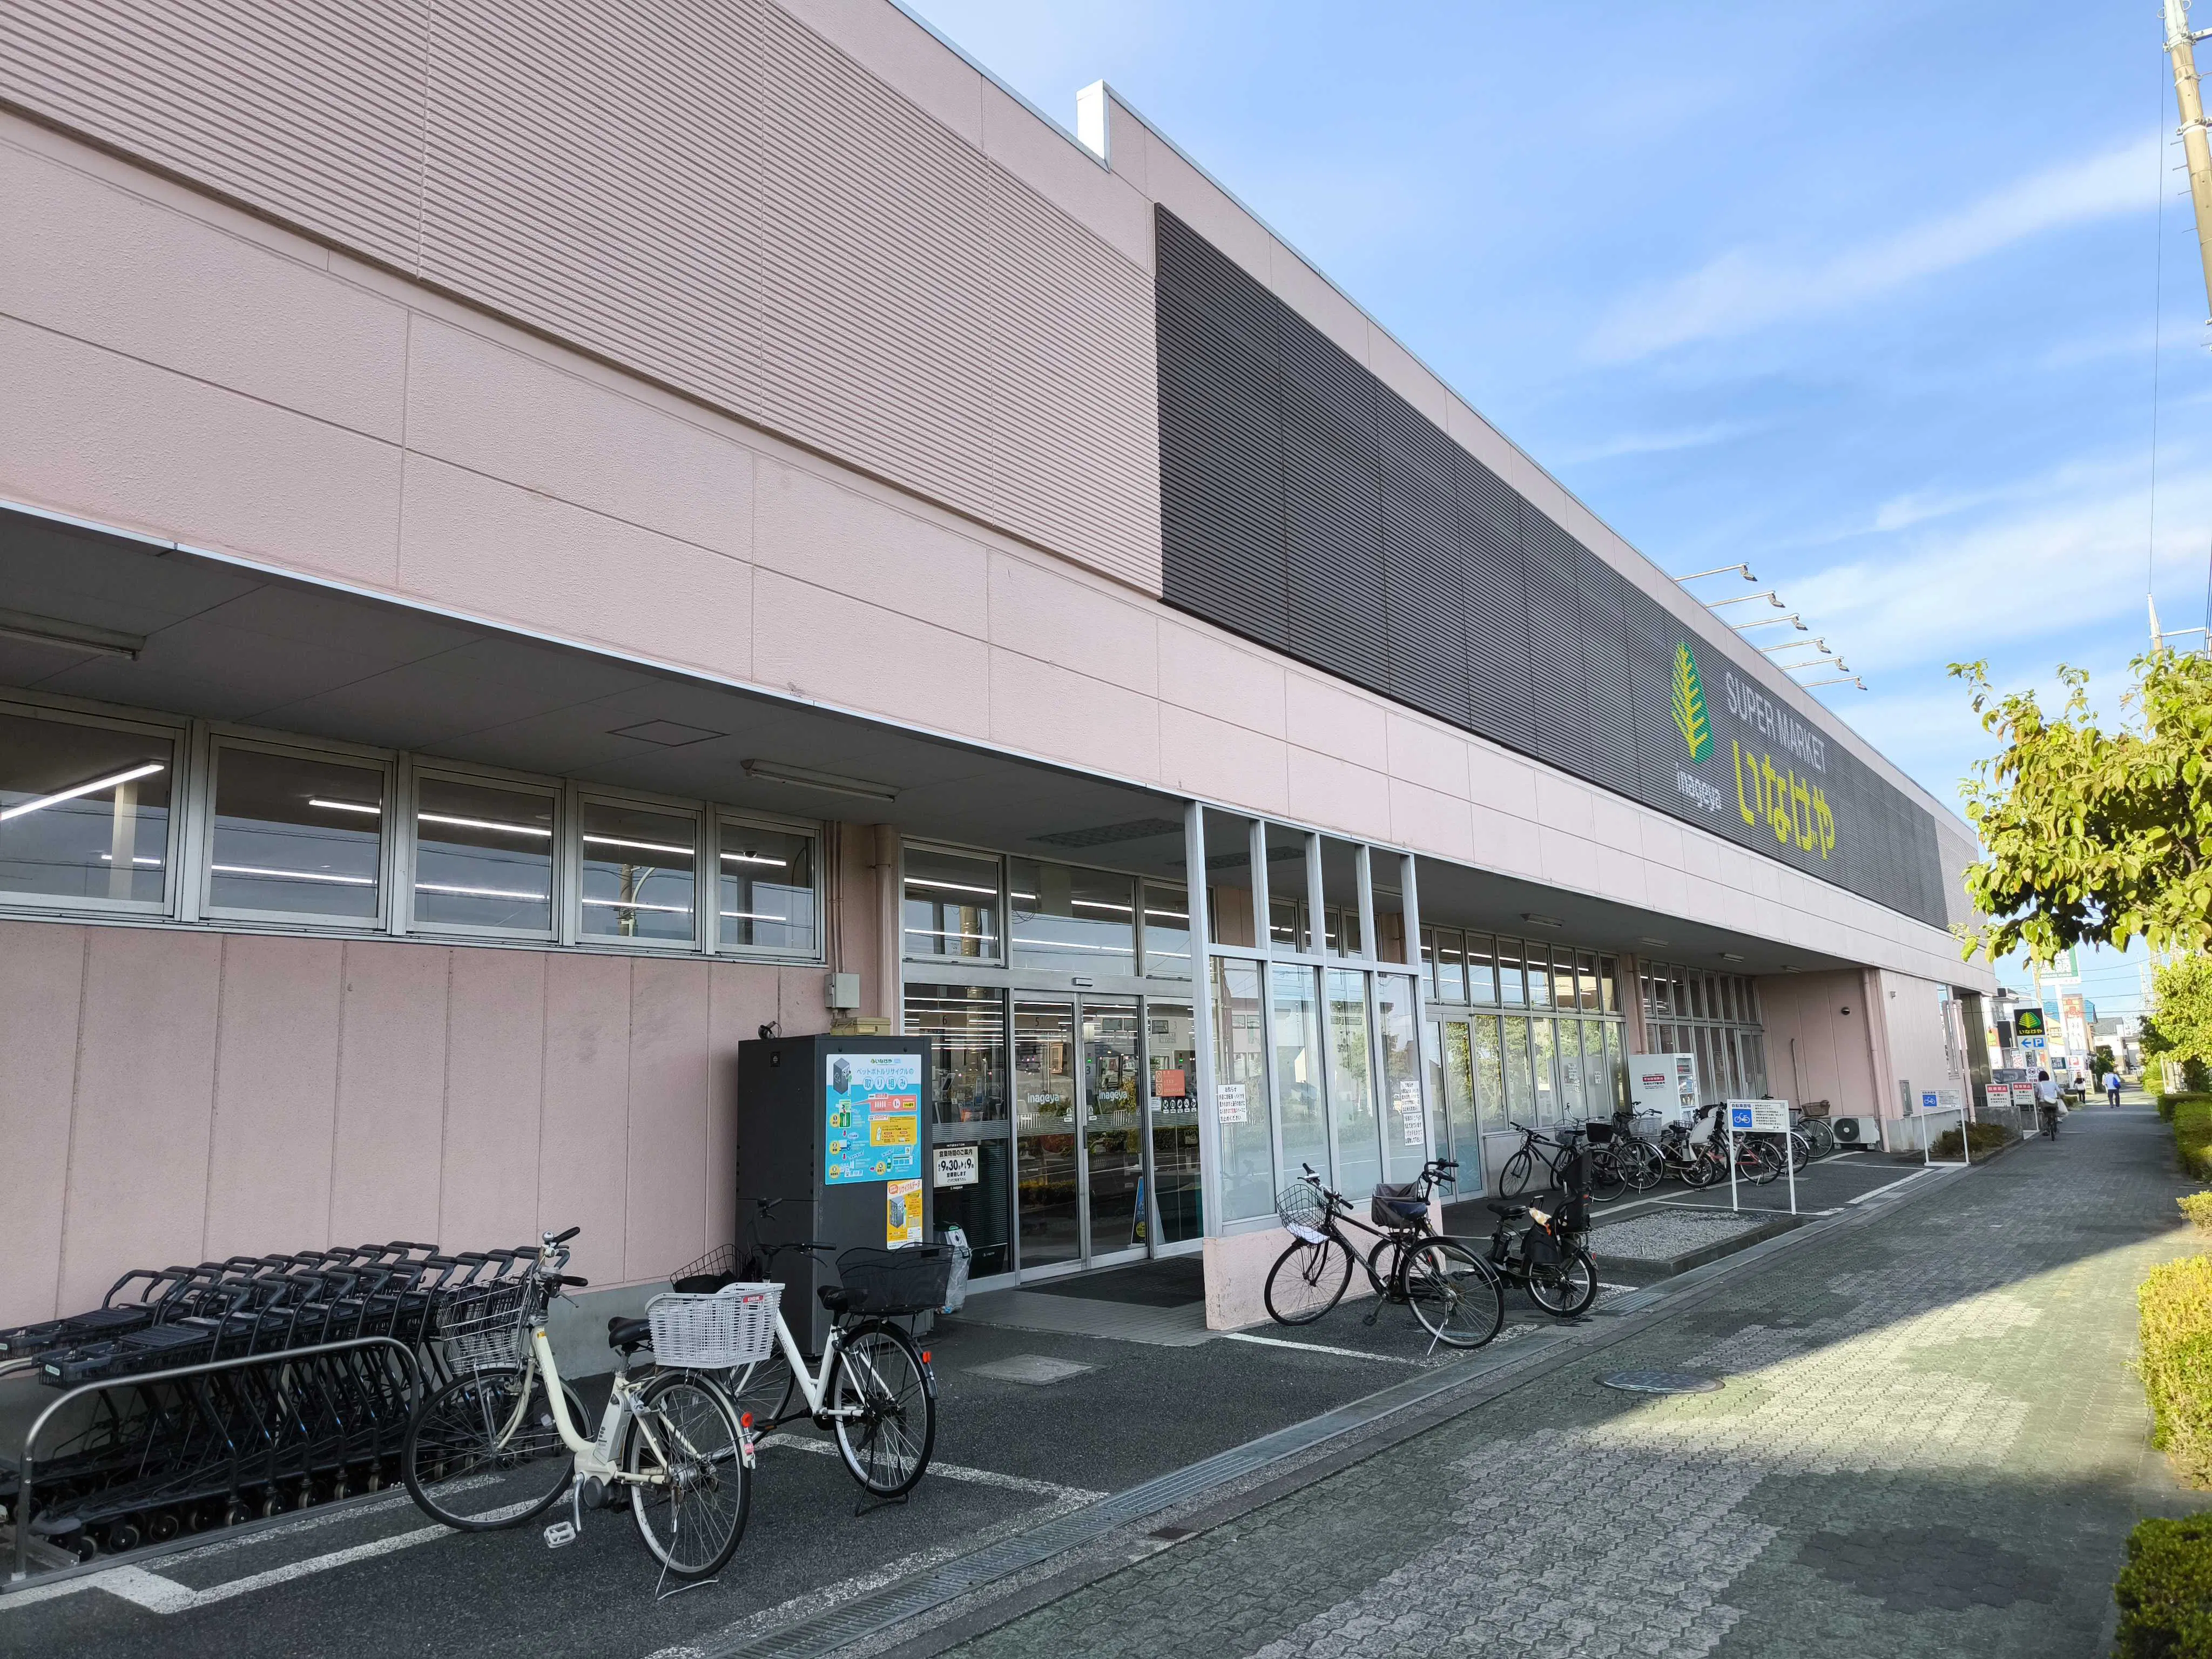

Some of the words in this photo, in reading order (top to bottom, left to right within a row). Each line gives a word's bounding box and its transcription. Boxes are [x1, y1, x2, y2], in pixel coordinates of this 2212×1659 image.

[1727, 671, 1776, 741] SUPER
[1777, 709, 1826, 773] MARKET
[1675, 761, 1722, 811] inageya
[1732, 739, 1834, 860] いなげや
[942, 1015, 947, 1024] 6
[1035, 1017, 1040, 1026] 5
[857, 1067, 914, 1075] ペットボトルリサイクルの
[865, 1078, 906, 1088] 取り組み
[1027, 1092, 1060, 1104] inageya
[1098, 1090, 1128, 1101] inageya
[939, 1149, 972, 1157] 営業時間のご案内
